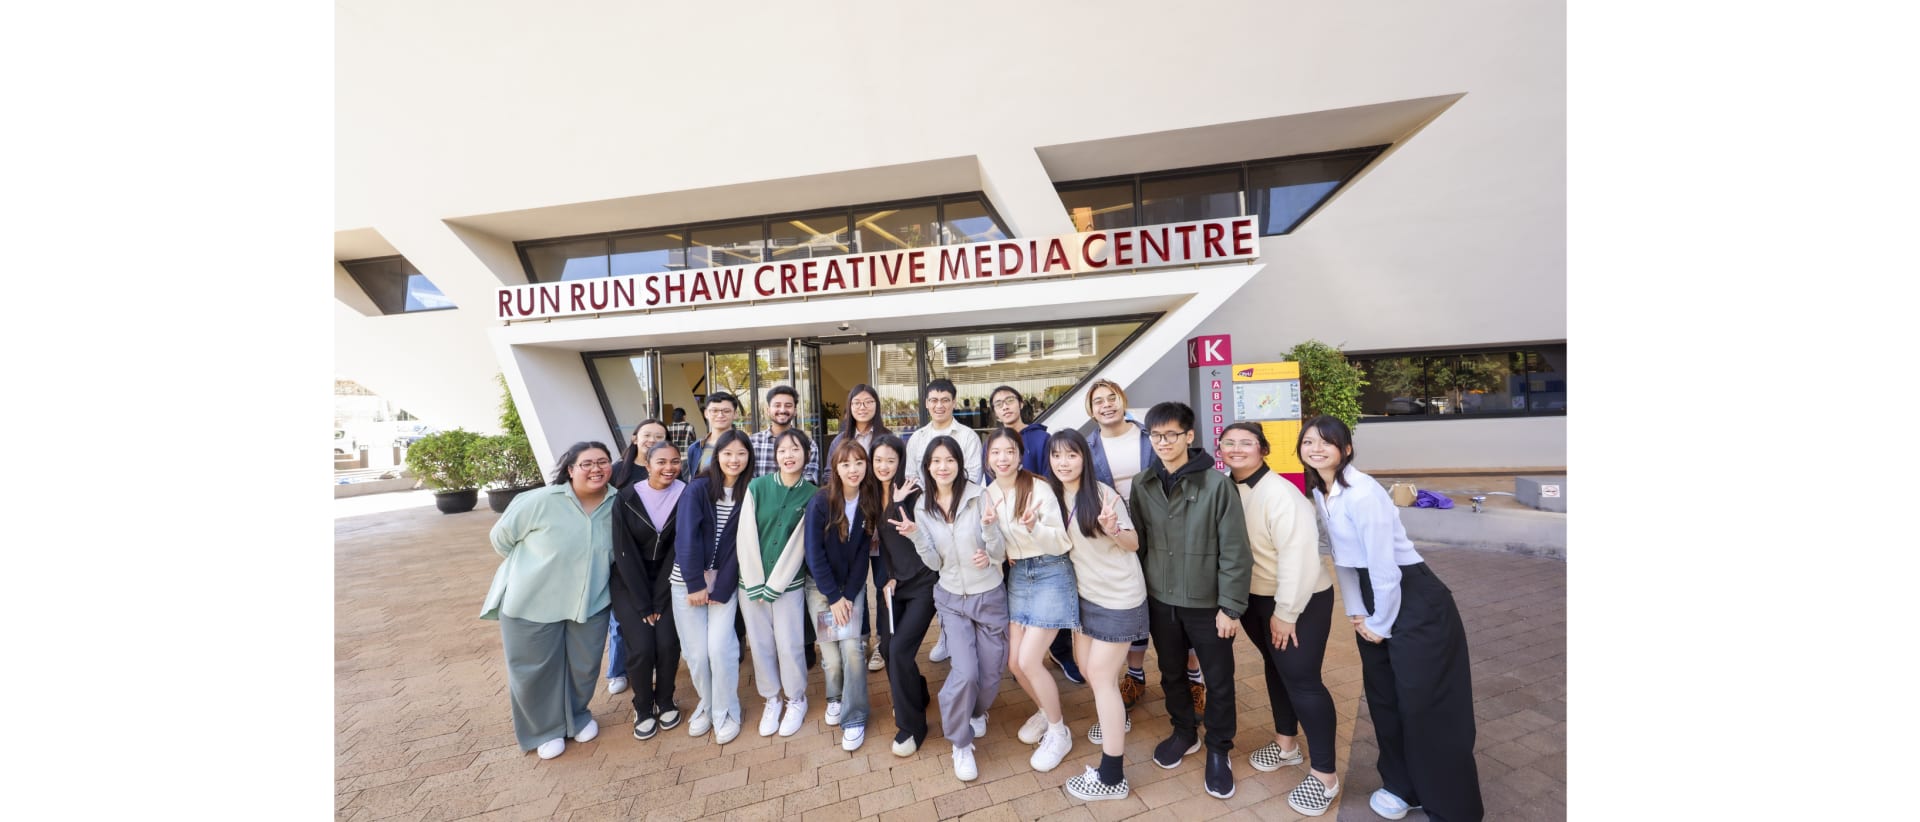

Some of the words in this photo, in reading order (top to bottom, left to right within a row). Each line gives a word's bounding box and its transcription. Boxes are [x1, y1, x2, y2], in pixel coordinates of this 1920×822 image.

[499, 285, 560, 317] RUN
[570, 278, 635, 311] RUN
[645, 268, 744, 306] SHAW
[754, 251, 926, 297] CREATIVE
[938, 238, 1071, 282] MEDIA
[1082, 219, 1254, 268] CENTRE
[1189, 342, 1197, 364] K
[1204, 339, 1225, 362] K
[1213, 381, 1220, 389] A
[1213, 392, 1220, 400] B
[1214, 415, 1221, 423] D
[1216, 461, 1223, 469] H
